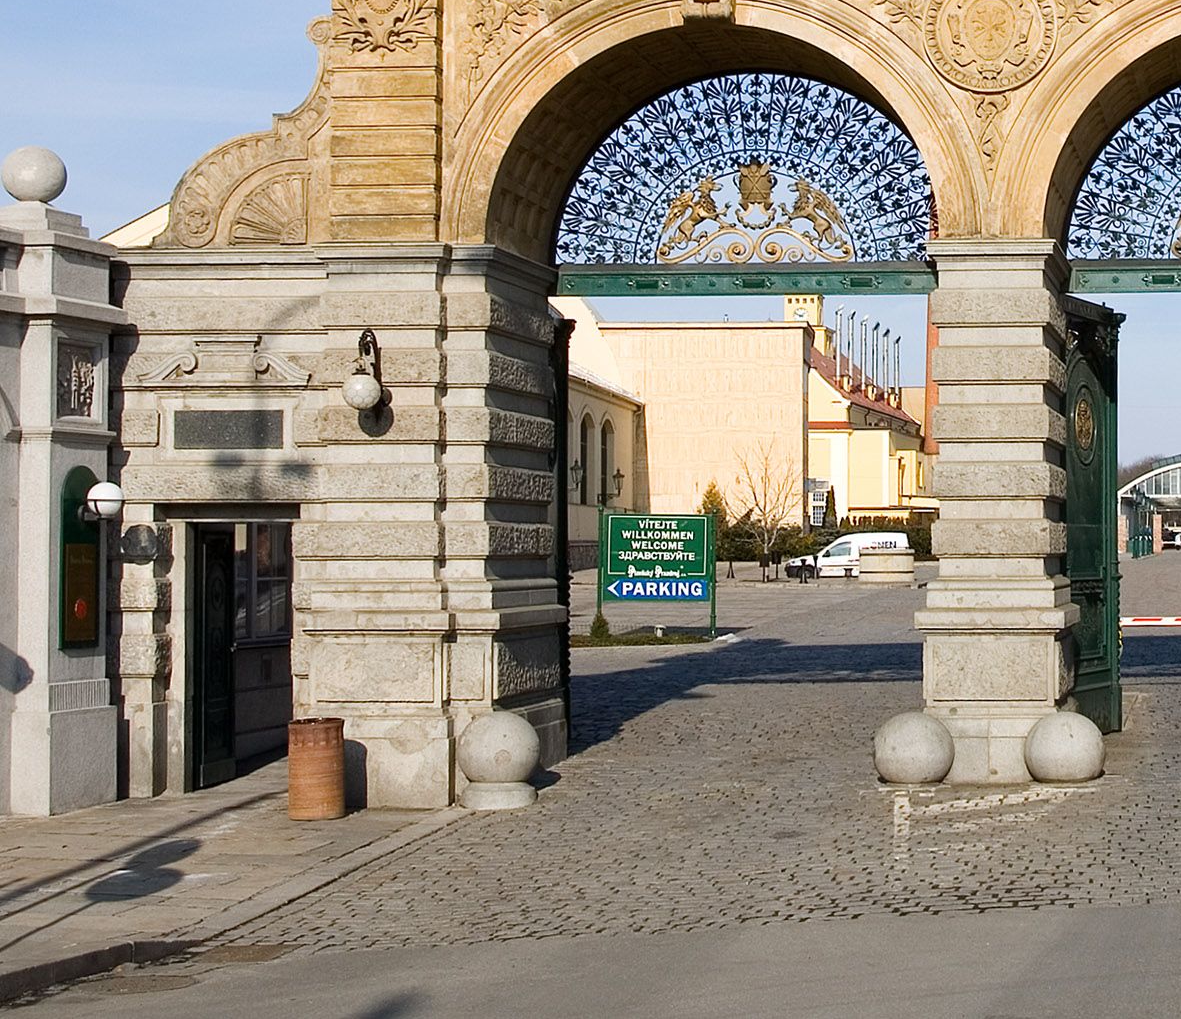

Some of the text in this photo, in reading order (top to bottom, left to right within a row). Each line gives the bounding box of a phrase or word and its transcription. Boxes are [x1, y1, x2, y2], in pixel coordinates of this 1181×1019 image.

[638, 519, 678, 529] VÍTEJTE
[622, 530, 694, 540] WILLKOMMEN
[631, 541, 684, 550] WELCOME
[618, 551, 696, 561] ЗДРАВСТВУЙТЕ
[622, 582, 703, 596] PARKING
